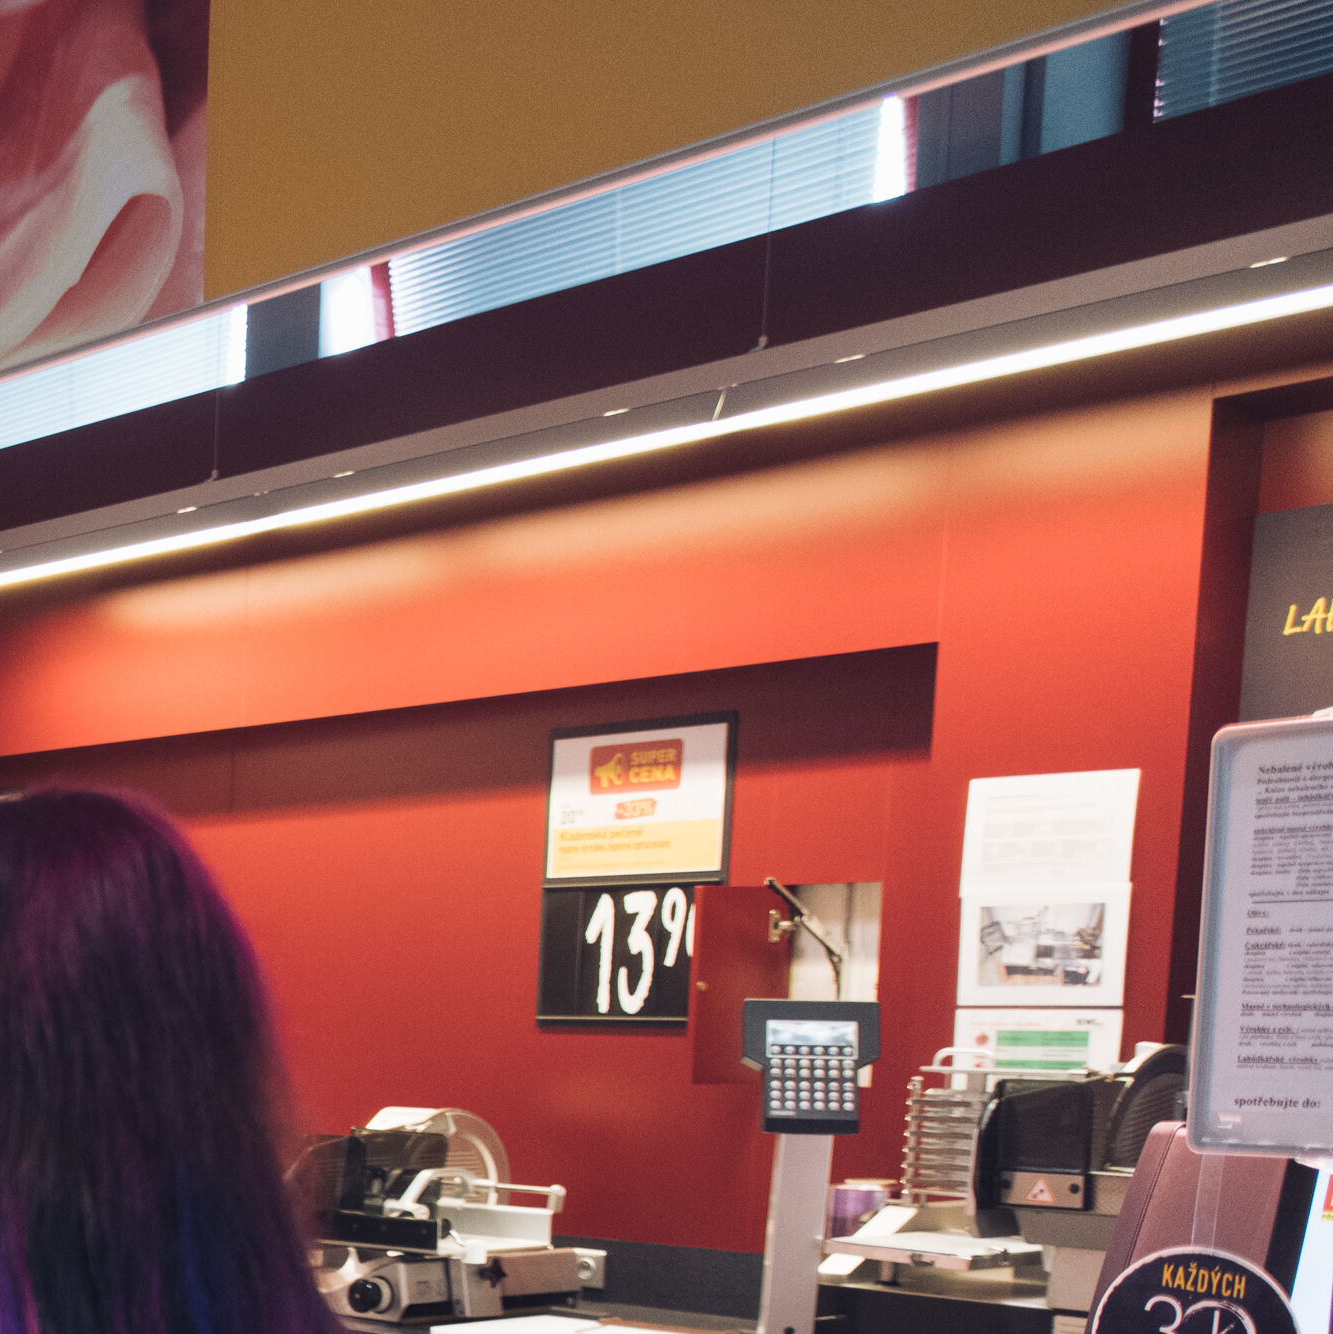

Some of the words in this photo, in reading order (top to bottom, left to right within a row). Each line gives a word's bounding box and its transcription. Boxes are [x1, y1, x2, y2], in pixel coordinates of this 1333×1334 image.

[628, 764, 676, 783] CENA
[1234, 1097, 1299, 1110] spotřebujte
[1301, 1098, 1321, 1109] do:
[1162, 1261, 1247, 1299] KAŽDÝCH
